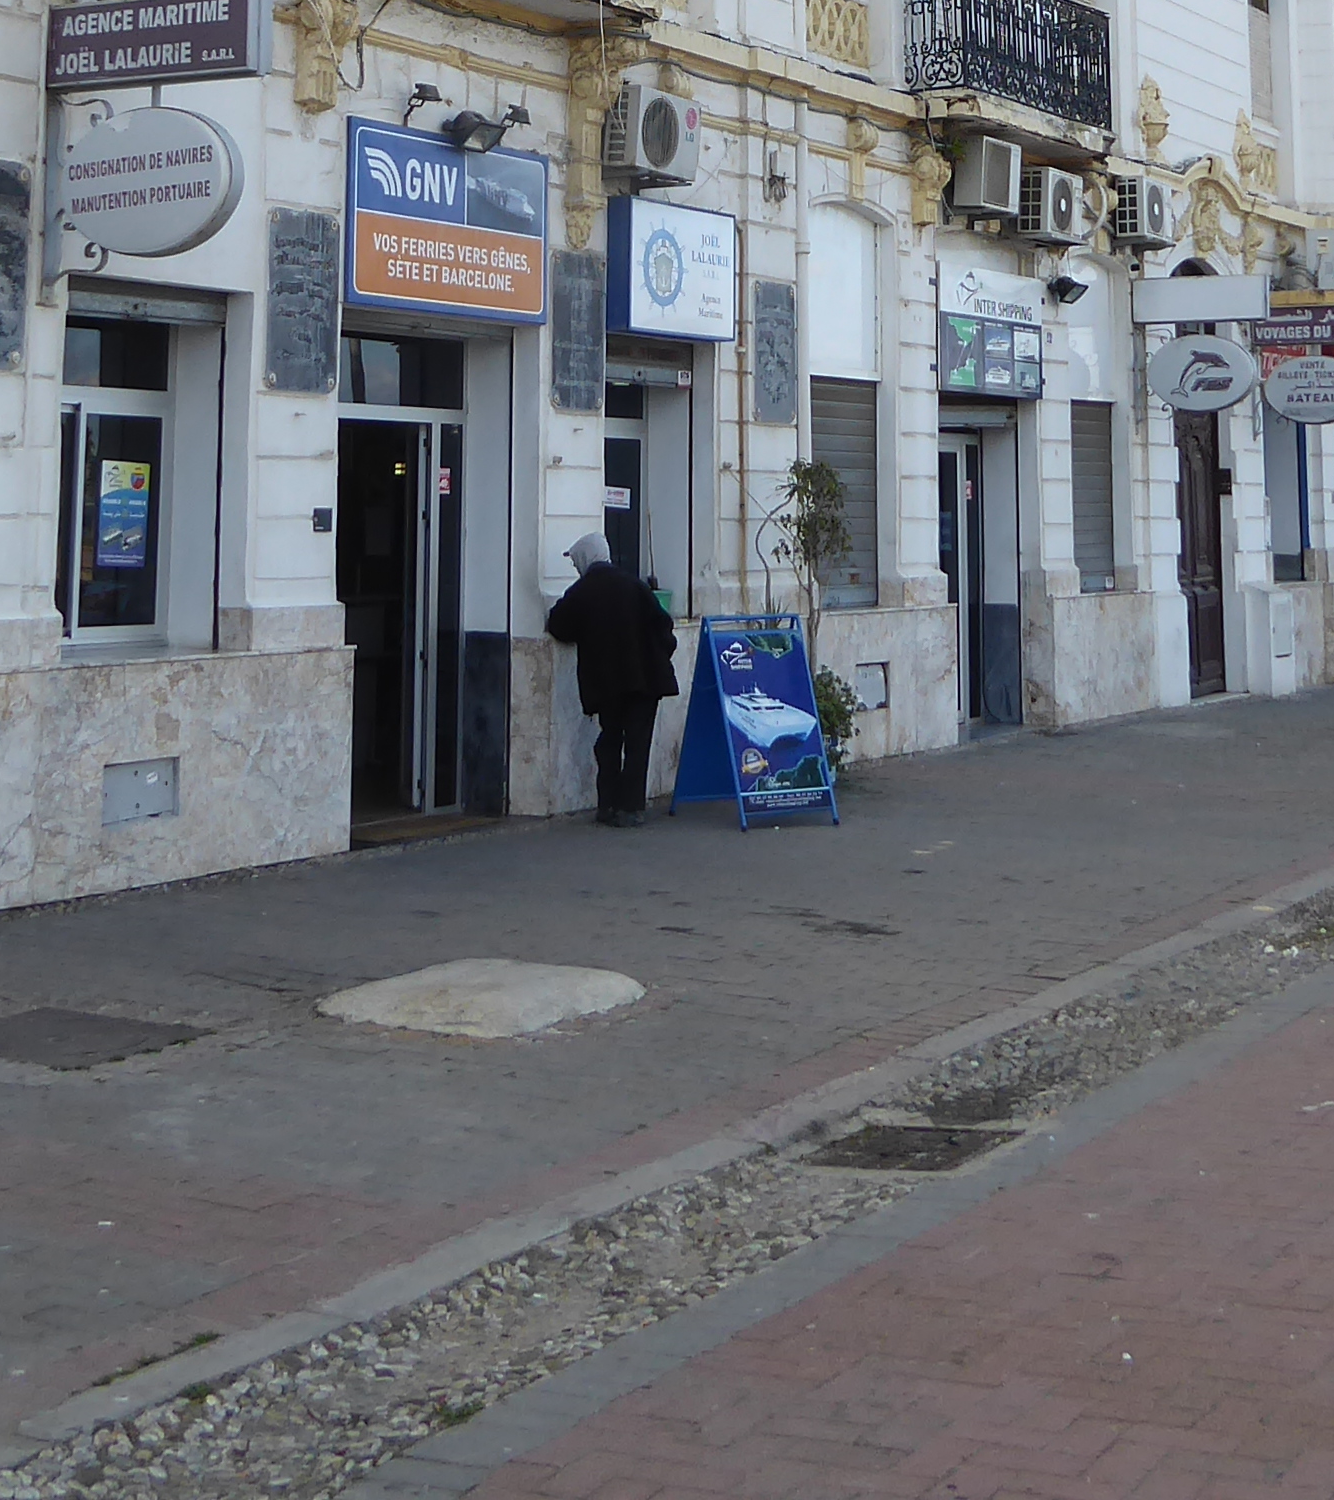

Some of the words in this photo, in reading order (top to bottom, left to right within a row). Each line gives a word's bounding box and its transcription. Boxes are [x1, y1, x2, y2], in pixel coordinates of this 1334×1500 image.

[62, 8, 134, 37] AGENCE
[55, 46, 100, 76] JOËL
[68, 153, 147, 182] CONSIGNATION
[149, 151, 163, 170] DE
[166, 144, 214, 168] NAVIRES
[71, 188, 147, 215] MANUTENTION
[149, 180, 211, 204] PORTUAIRE
[405, 158, 458, 206] GNV
[373, 232, 398, 253] VOS
[401, 236, 455, 261] FERRIES
[457, 244, 488, 266] VERS
[490, 246, 532, 274] GÊNES,
[690, 249, 730, 268] LALAURIE
[387, 255, 420, 281] SÈTE
[423, 264, 439, 283] ET
[441, 267, 515, 293] BARCELONE.
[974, 298, 997, 317] INTER
[997, 301, 1033, 322] SHIPPING
[1255, 325, 1311, 339] VOYAGES
[1313, 325, 1331, 338] DU
